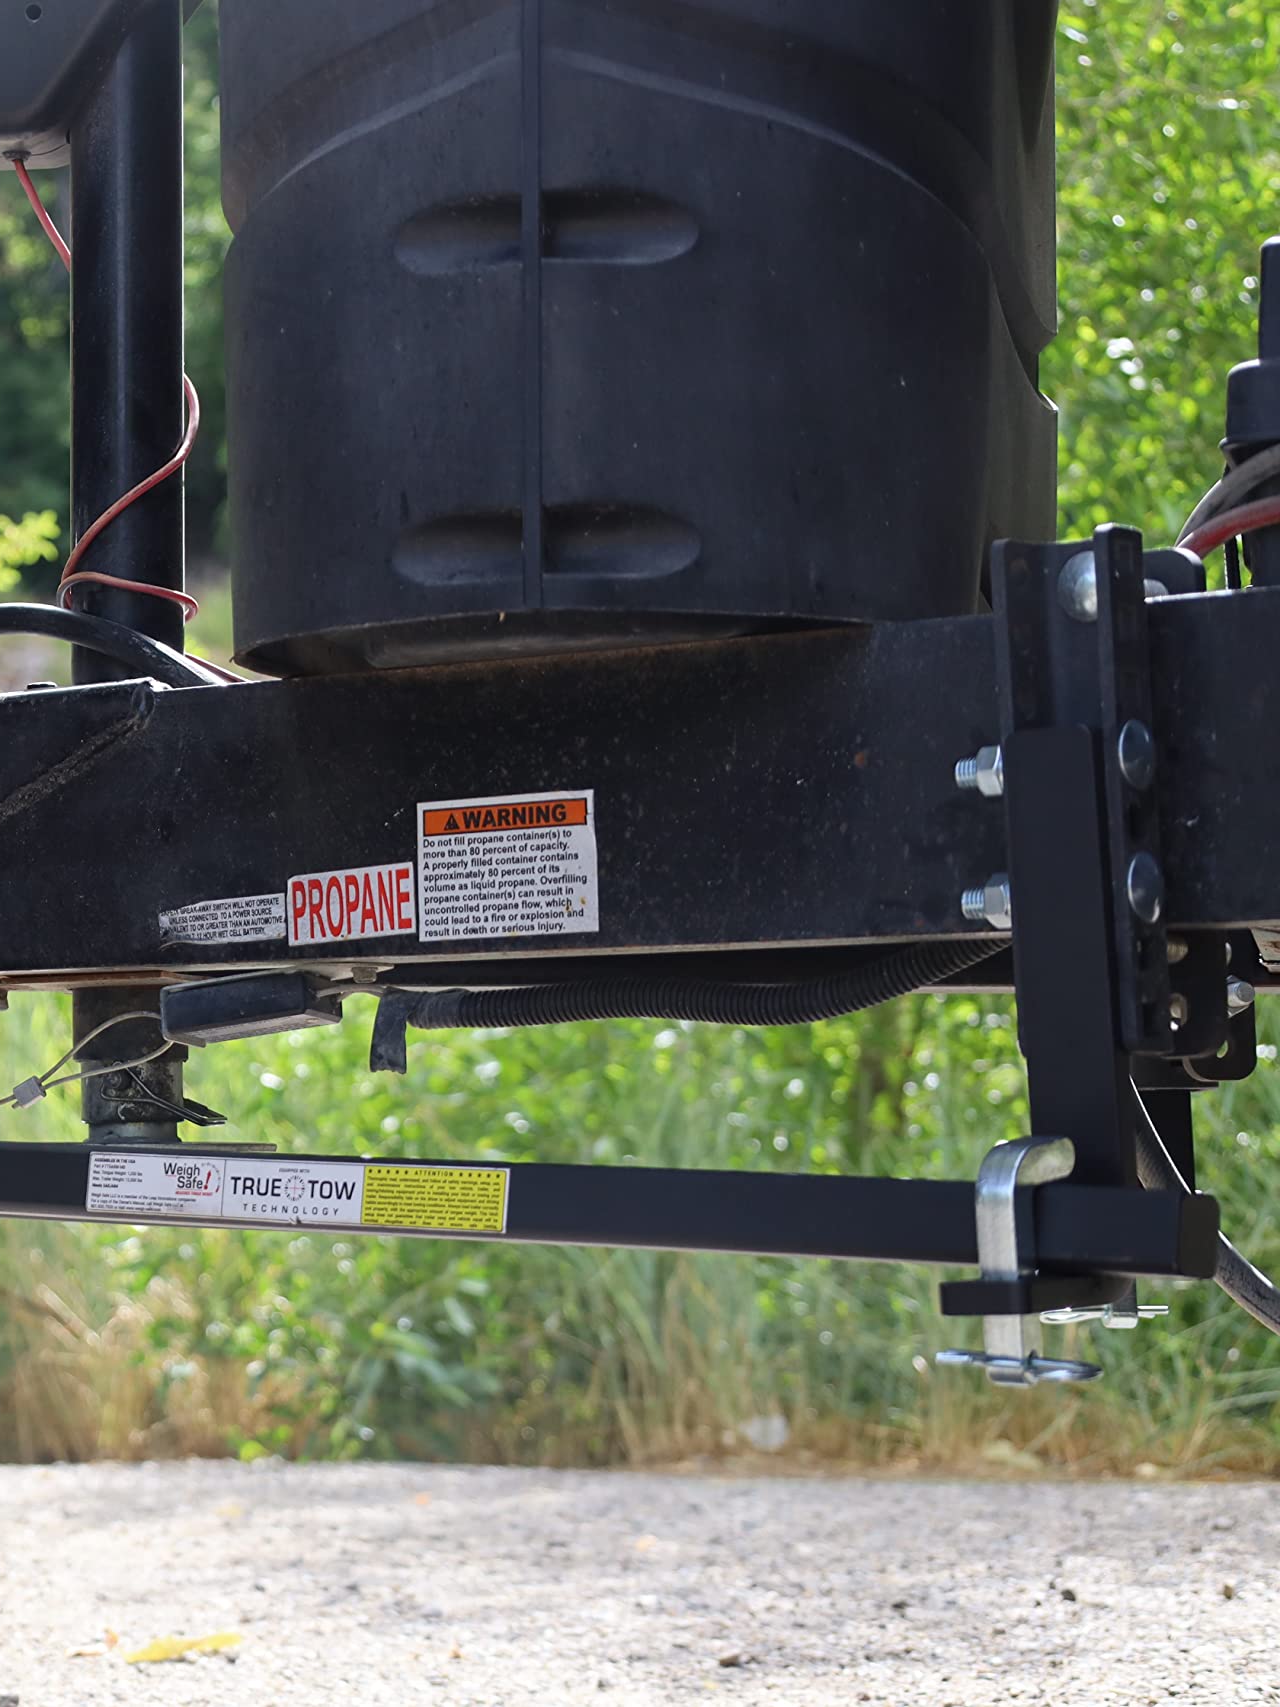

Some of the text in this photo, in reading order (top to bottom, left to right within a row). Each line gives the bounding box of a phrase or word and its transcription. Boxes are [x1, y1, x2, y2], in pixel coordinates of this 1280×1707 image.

[462, 804, 566, 828] WARNING
[423, 830, 572, 848] Do not fill propane container(s) to
[424, 842, 569, 859] more than 80 percent of capacity.
[424, 852, 578, 871] A properly filled container contains
[424, 871, 485, 884] approximately
[488, 869, 498, 877] 80
[501, 867, 535, 879] percent
[538, 865, 546, 873] of
[424, 874, 587, 892] volume as liquid propane. Overfilling
[257, 897, 279, 906] OPERATE
[292, 868, 412, 940] PROPANE
[425, 895, 460, 905] propane
[462, 890, 515, 901] container(s)
[537, 887, 563, 896] result
[565, 886, 573, 894] in
[189, 913, 218, 922] CONNECTED
[233, 909, 251, 917] POWER
[252, 907, 271, 916] SOURCE
[425, 898, 572, 915] uncontrolled propane flow, which
[251, 916, 282, 925] AUTOMOTIVE
[425, 917, 448, 926] could
[452, 915, 470, 924] lead
[472, 914, 481, 923] to
[491, 913, 505, 922] fire
[521, 911, 564, 922] explosion
[567, 909, 584, 917] and
[203, 931, 217, 939] HOUR
[425, 922, 565, 937] result in death or serious injury.
[164, 1162, 200, 1178] Weigh
[231, 1176, 356, 1200] TRUE TOW
[243, 1203, 339, 1216] TECHNOLOGY
